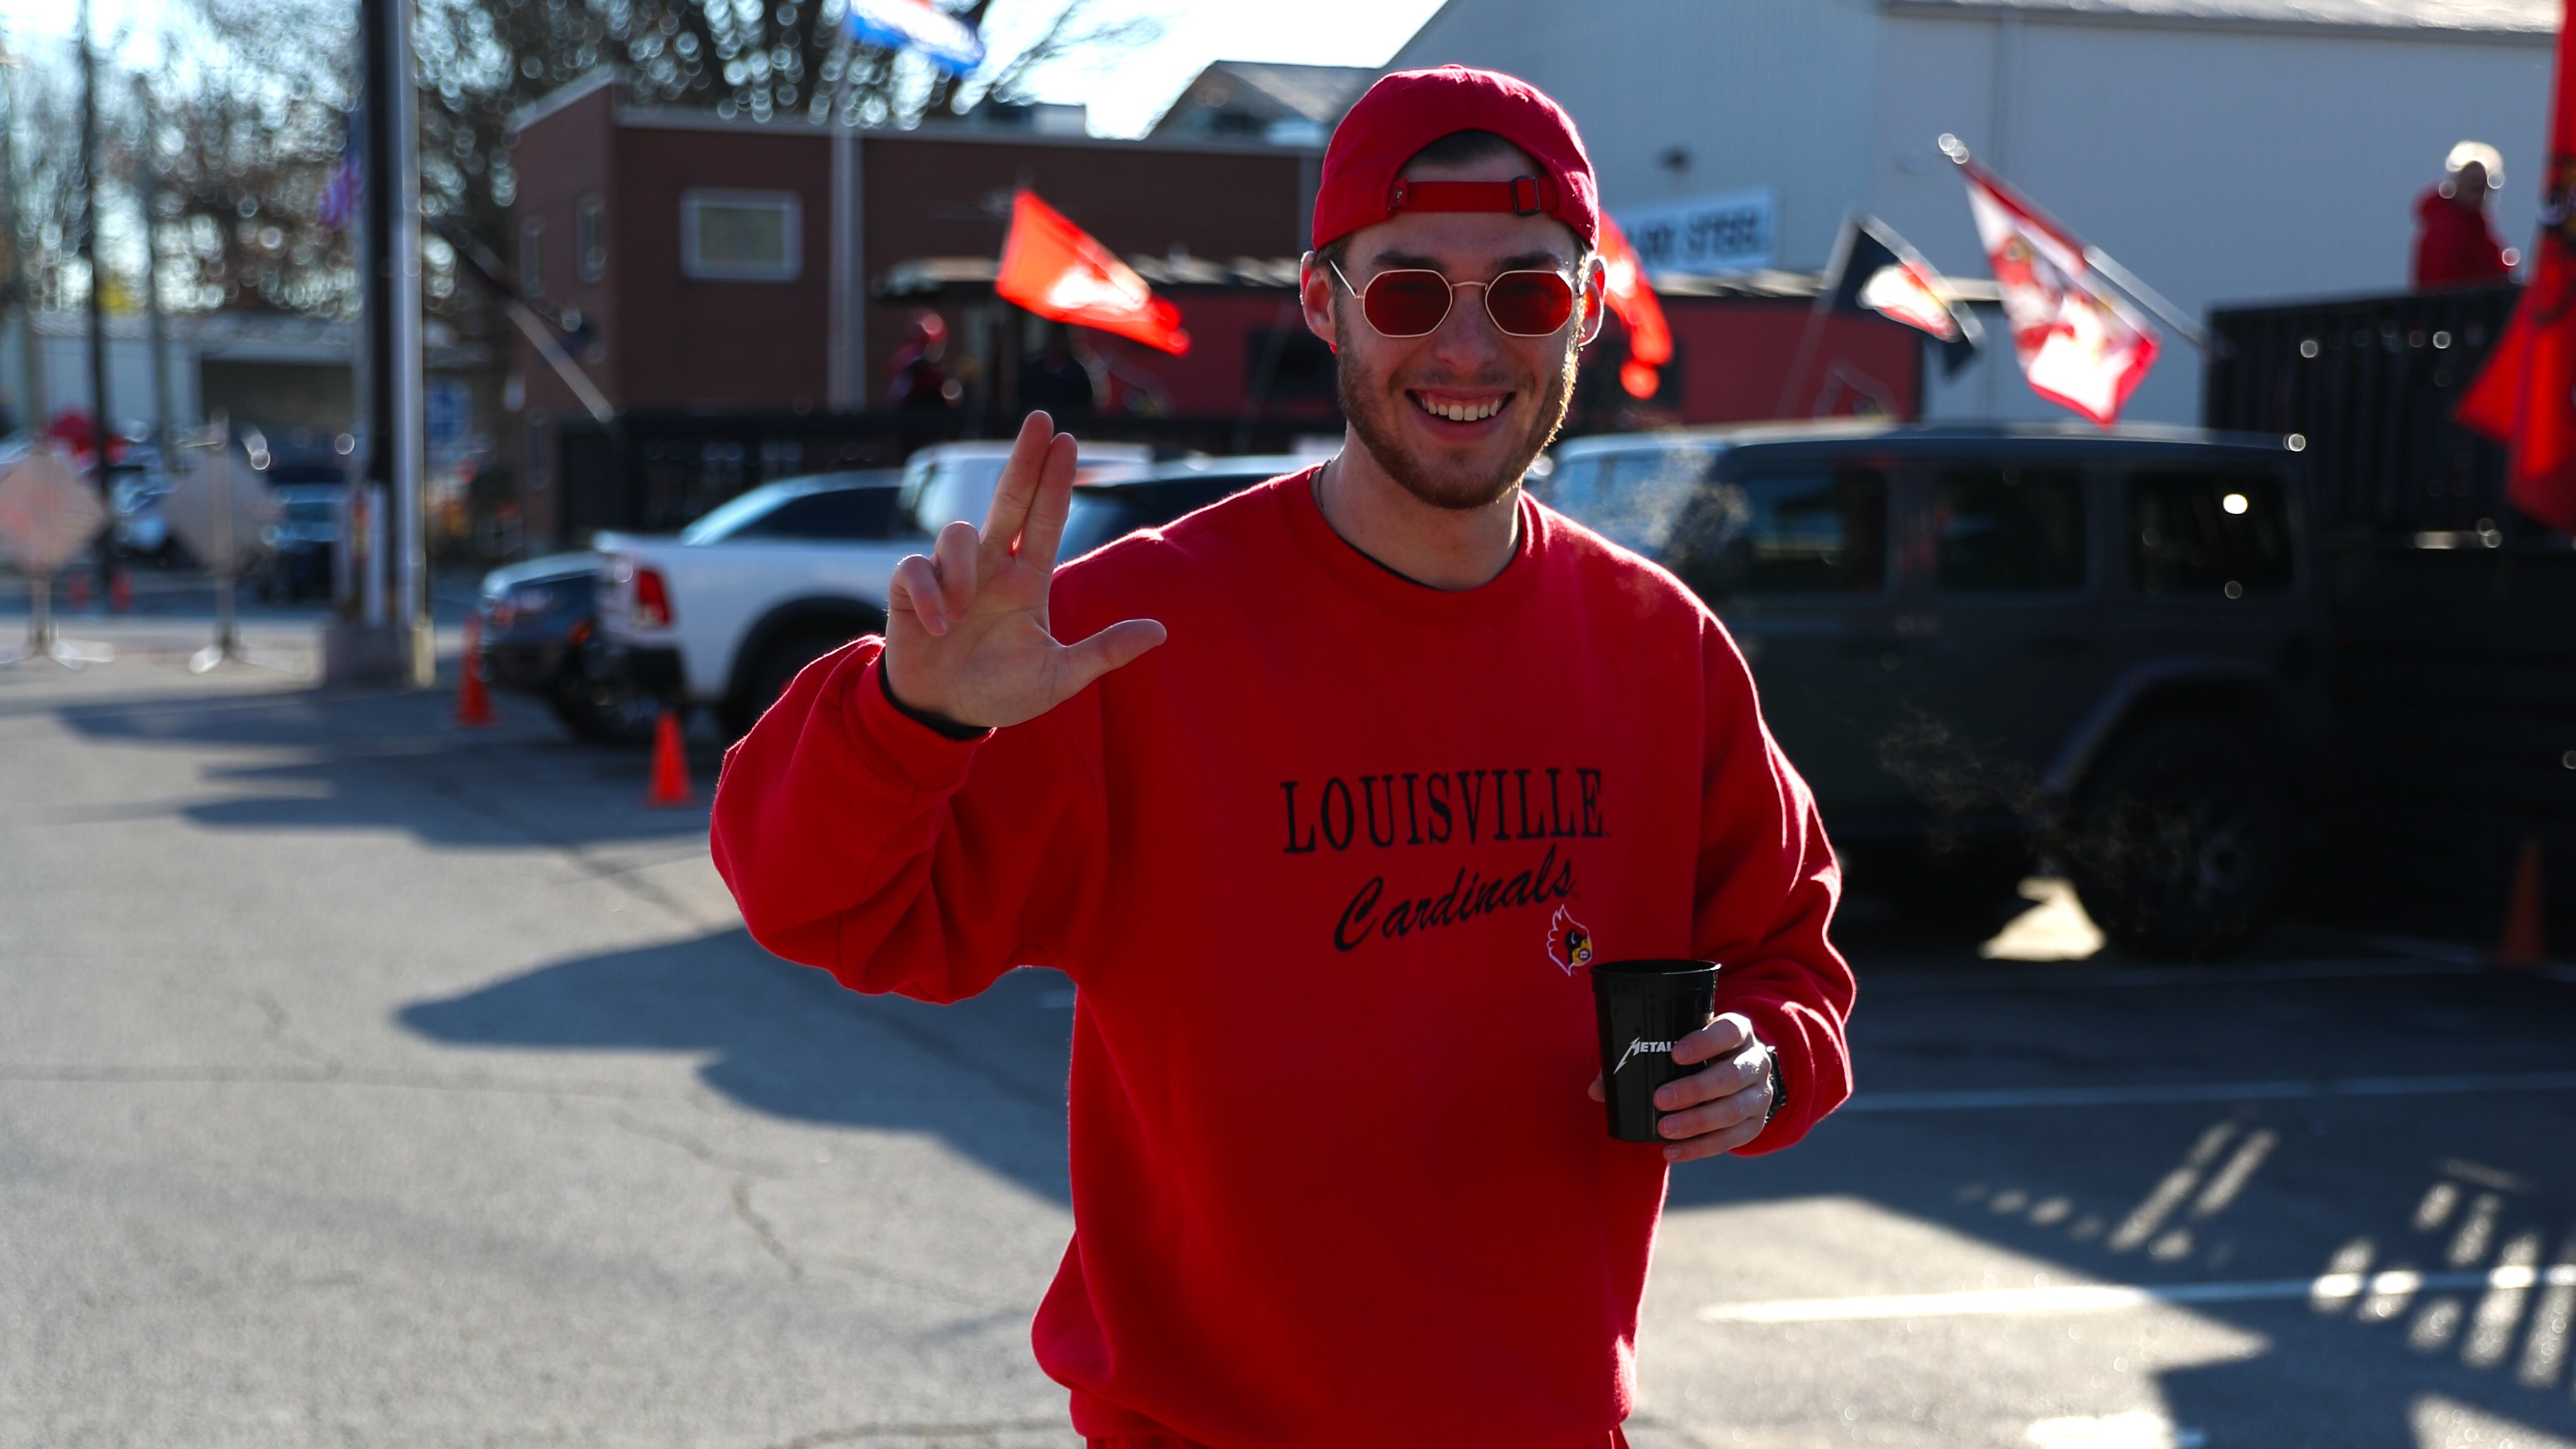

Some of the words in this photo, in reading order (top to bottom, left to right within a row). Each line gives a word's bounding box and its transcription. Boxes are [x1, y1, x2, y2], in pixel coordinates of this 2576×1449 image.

[1280, 768, 1603, 854] LOUISVILLE
[1334, 843, 1576, 952] Cardinals
[1613, 1036, 1678, 1075] METAL
